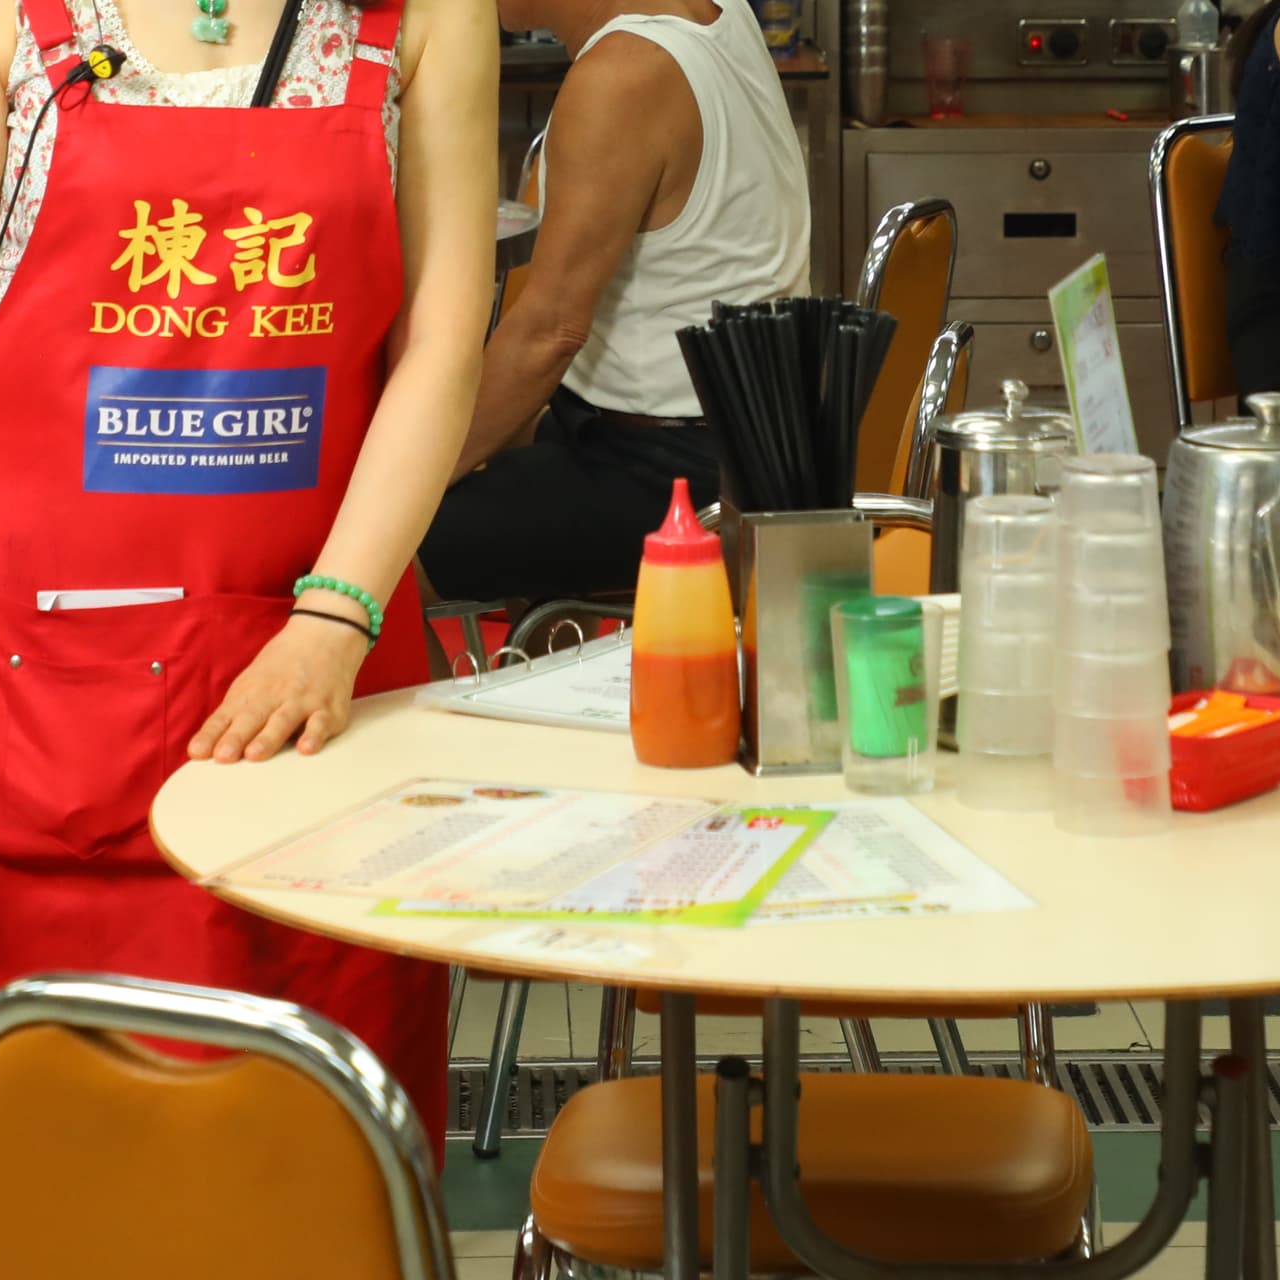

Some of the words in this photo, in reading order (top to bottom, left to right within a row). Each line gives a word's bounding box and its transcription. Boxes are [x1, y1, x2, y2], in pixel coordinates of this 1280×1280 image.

[110, 197, 316, 300] 棟記
[88, 301, 229, 339] DONG
[249, 302, 333, 338] KEE
[96, 407, 206, 438] BLUE
[113, 452, 187, 467] IMPORTED
[190, 453, 256, 467] PREMIUM
[258, 451, 290, 465] BEER
